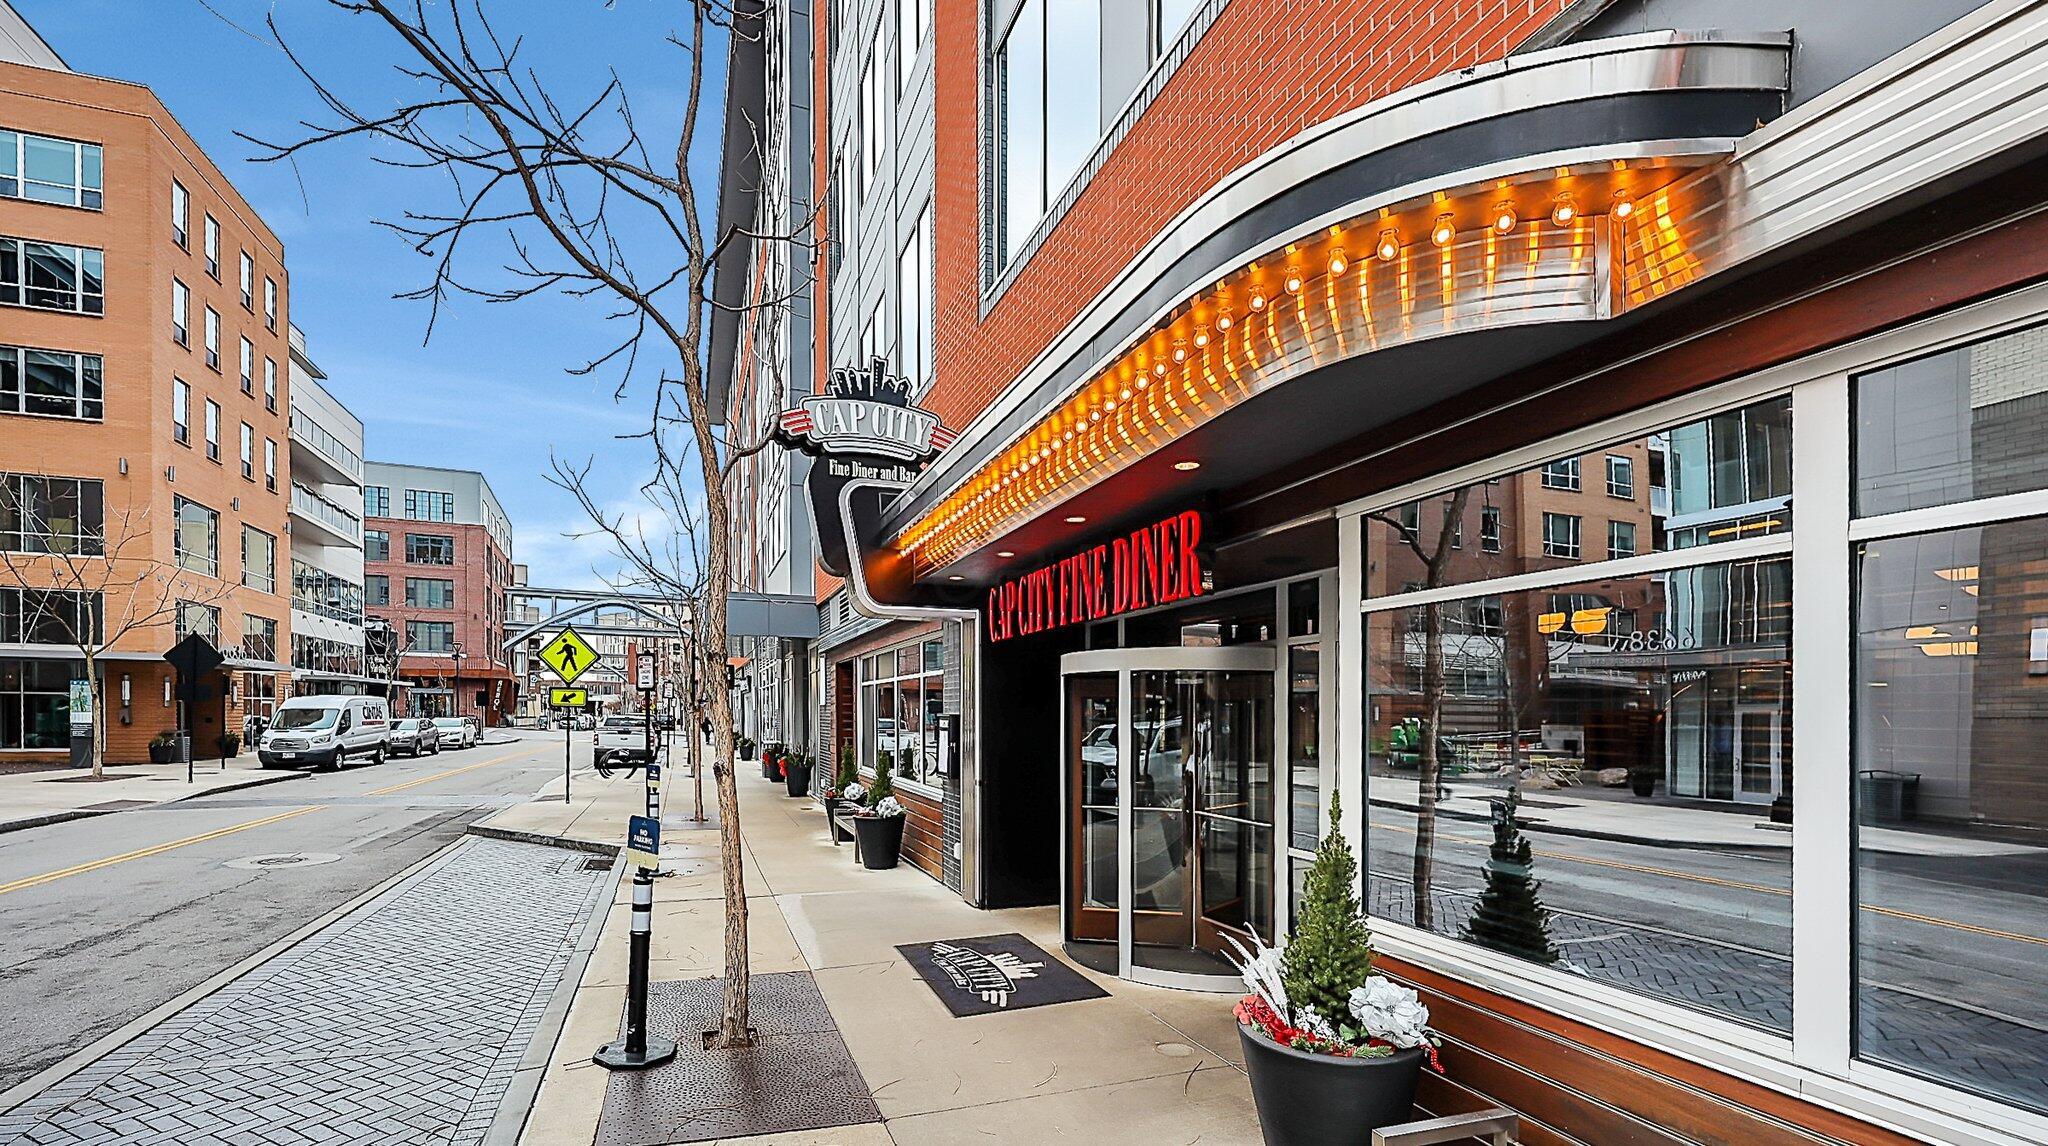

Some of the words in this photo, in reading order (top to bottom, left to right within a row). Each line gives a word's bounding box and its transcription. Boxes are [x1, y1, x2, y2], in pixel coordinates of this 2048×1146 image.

[815, 401, 866, 435] CAP
[871, 404, 931, 448] CITY
[828, 459, 850, 477] Fine
[851, 461, 878, 478] Diner
[879, 465, 898, 481] and
[899, 465, 917, 483] Bar
[989, 581, 1017, 643] CAP
[1017, 563, 1058, 636] CITY
[1059, 544, 1107, 626] FINE
[1112, 509, 1205, 614] DINER
